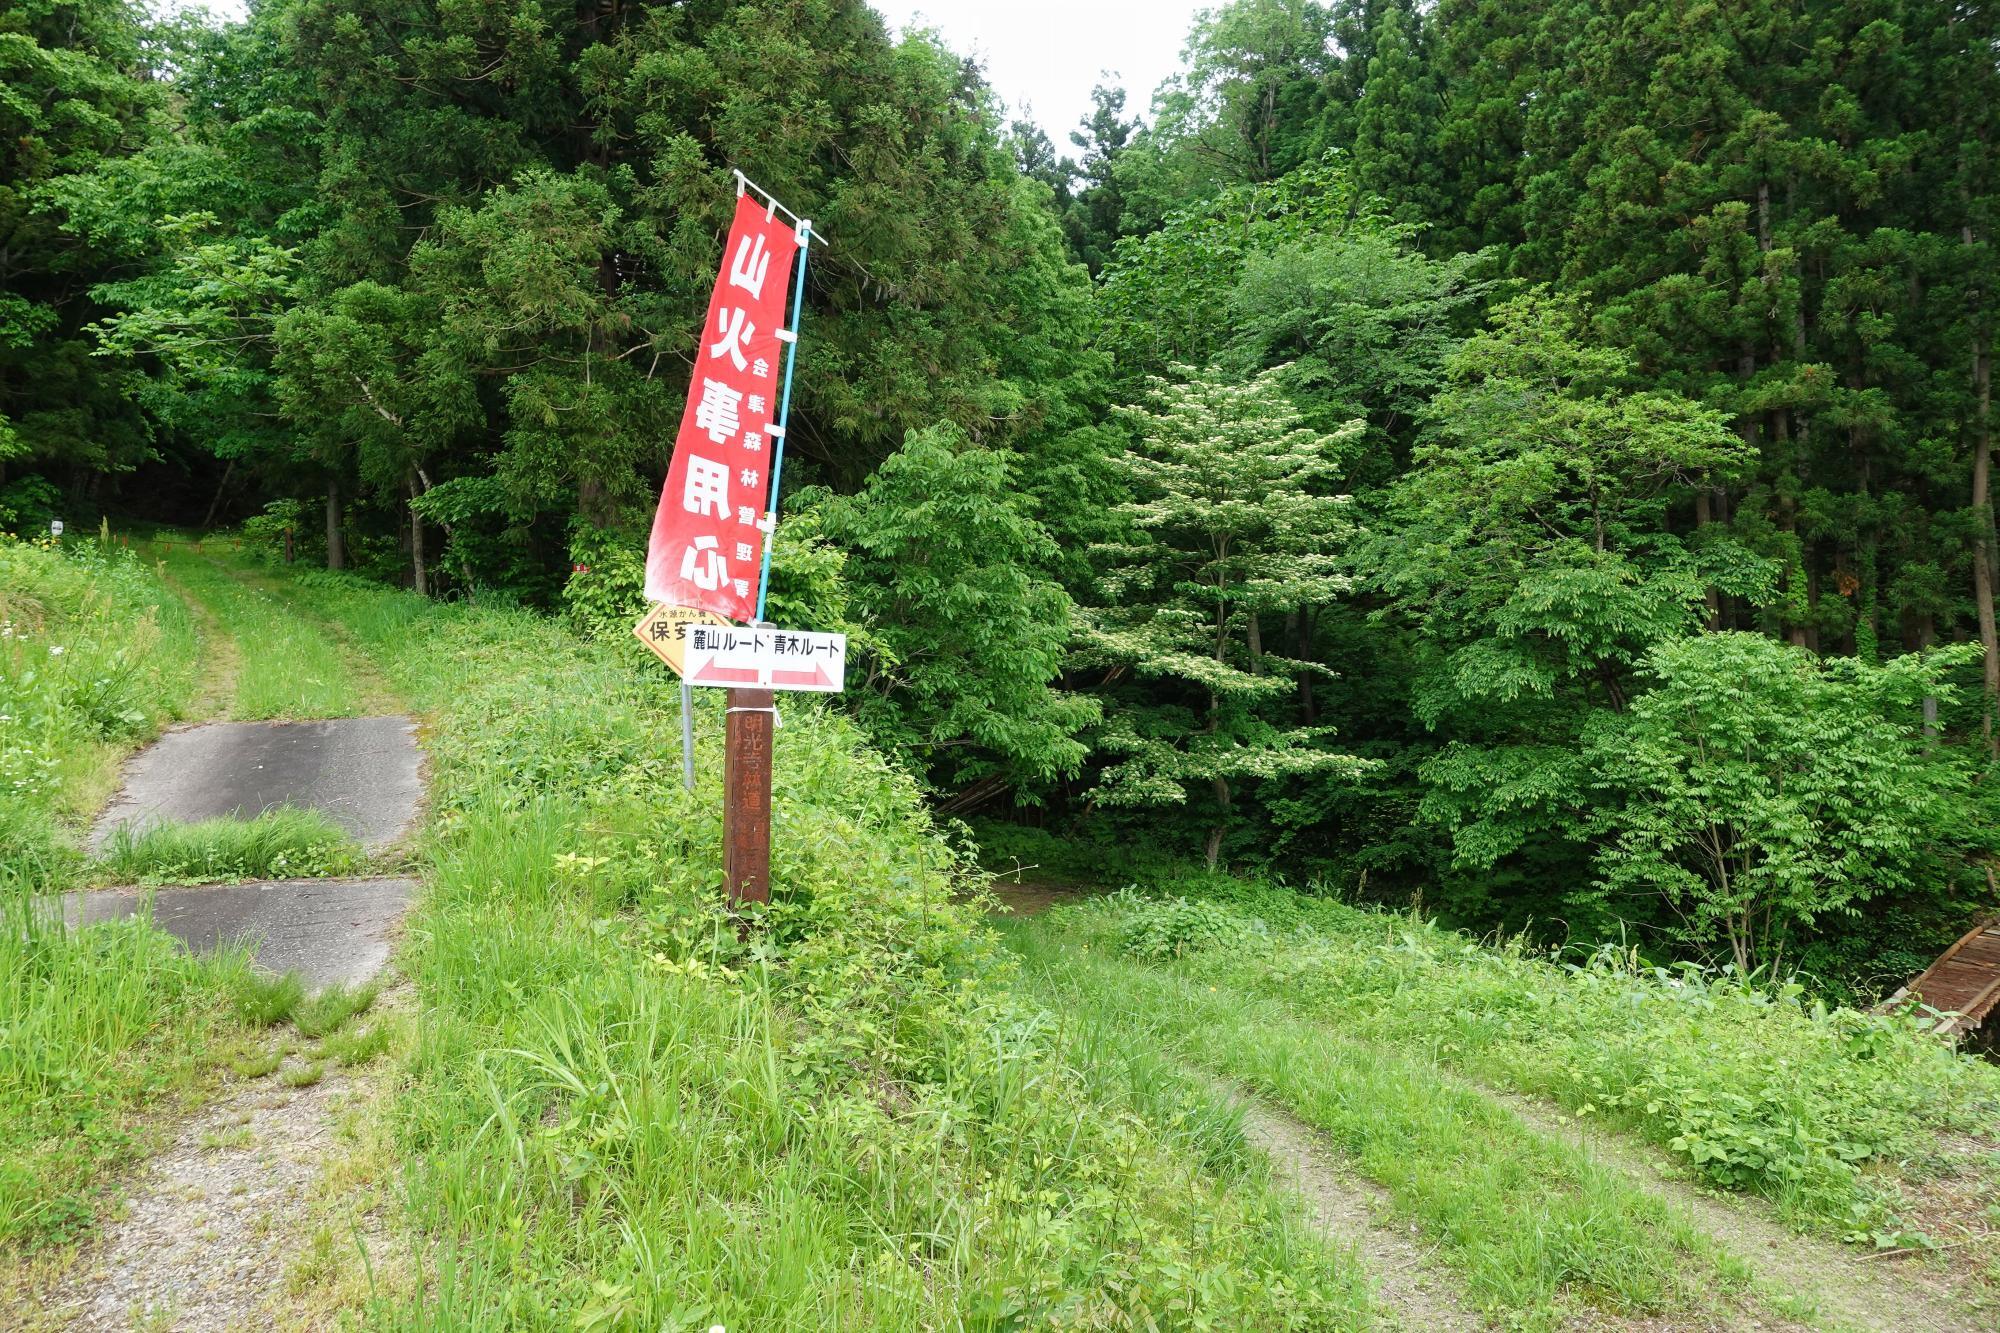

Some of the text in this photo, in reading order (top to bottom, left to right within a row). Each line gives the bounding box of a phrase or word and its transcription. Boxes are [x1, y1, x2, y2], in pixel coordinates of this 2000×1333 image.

[649, 620, 718, 642] 保安
[693, 629, 839, 659] 麓山ルート 青木ルート
